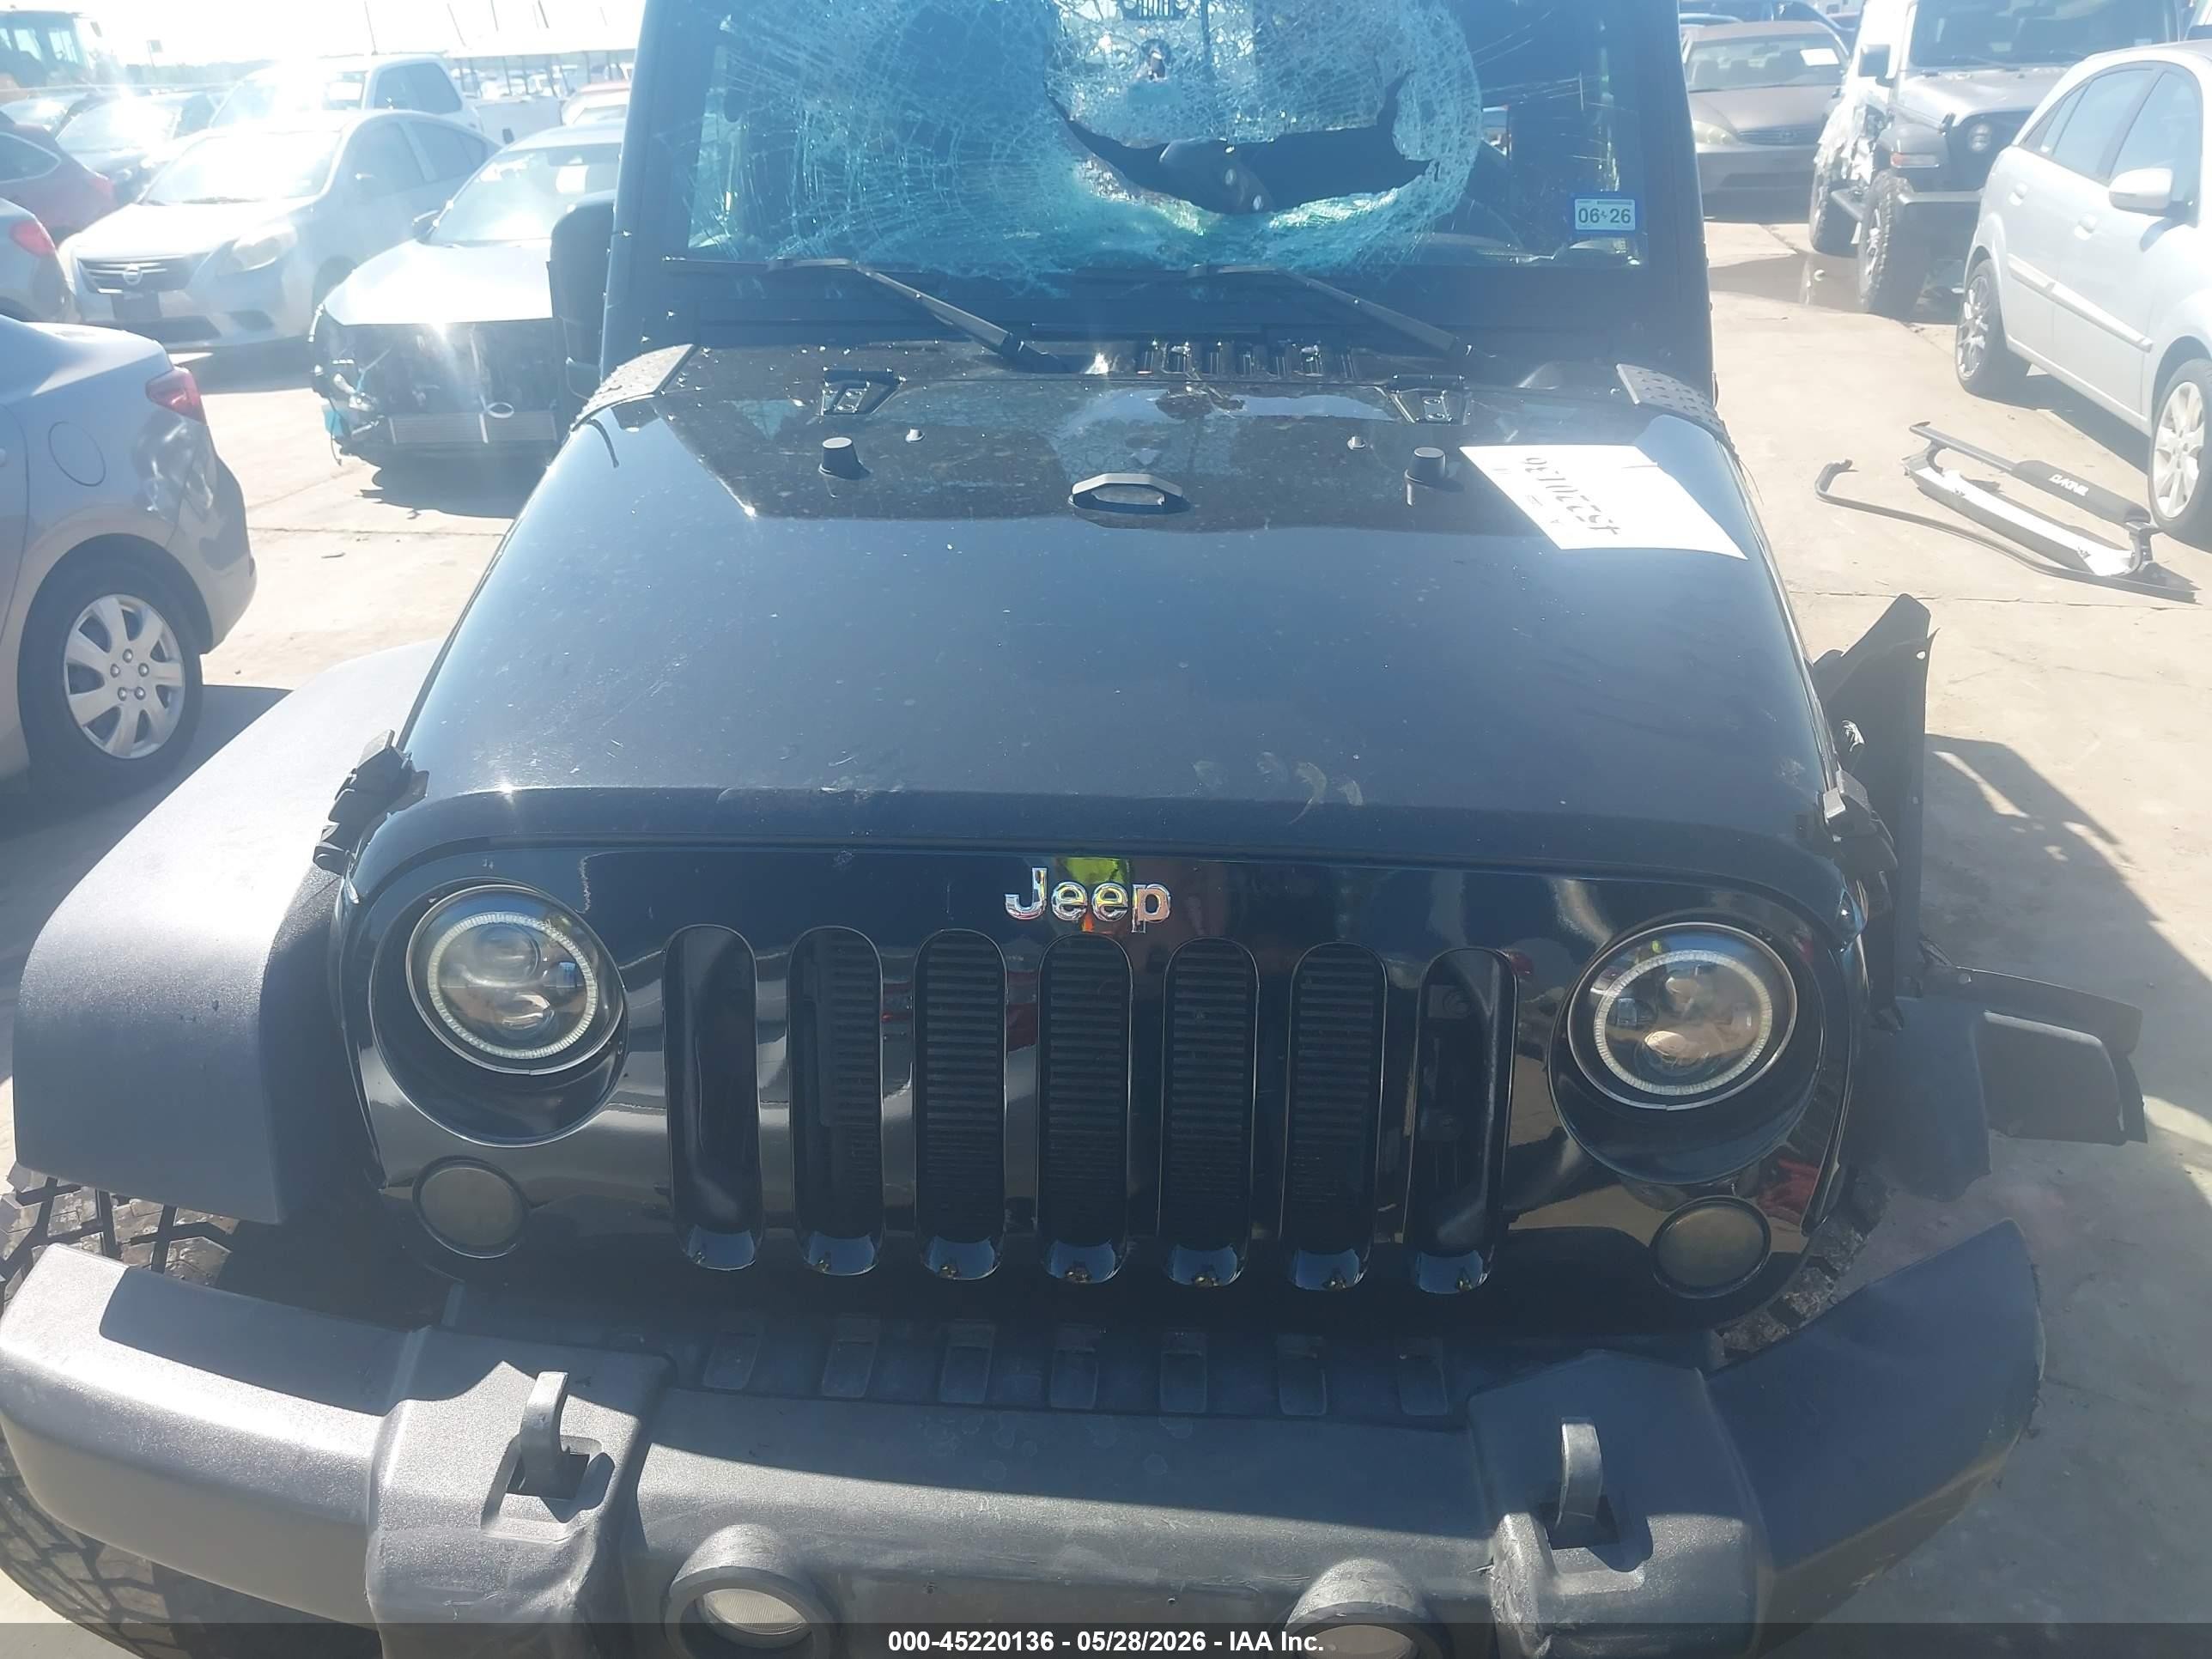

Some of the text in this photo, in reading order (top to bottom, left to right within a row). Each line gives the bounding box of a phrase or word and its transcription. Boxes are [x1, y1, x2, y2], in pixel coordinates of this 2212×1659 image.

[1578, 208, 1632, 224] 06 26
[1004, 866, 1172, 933] Jeep
